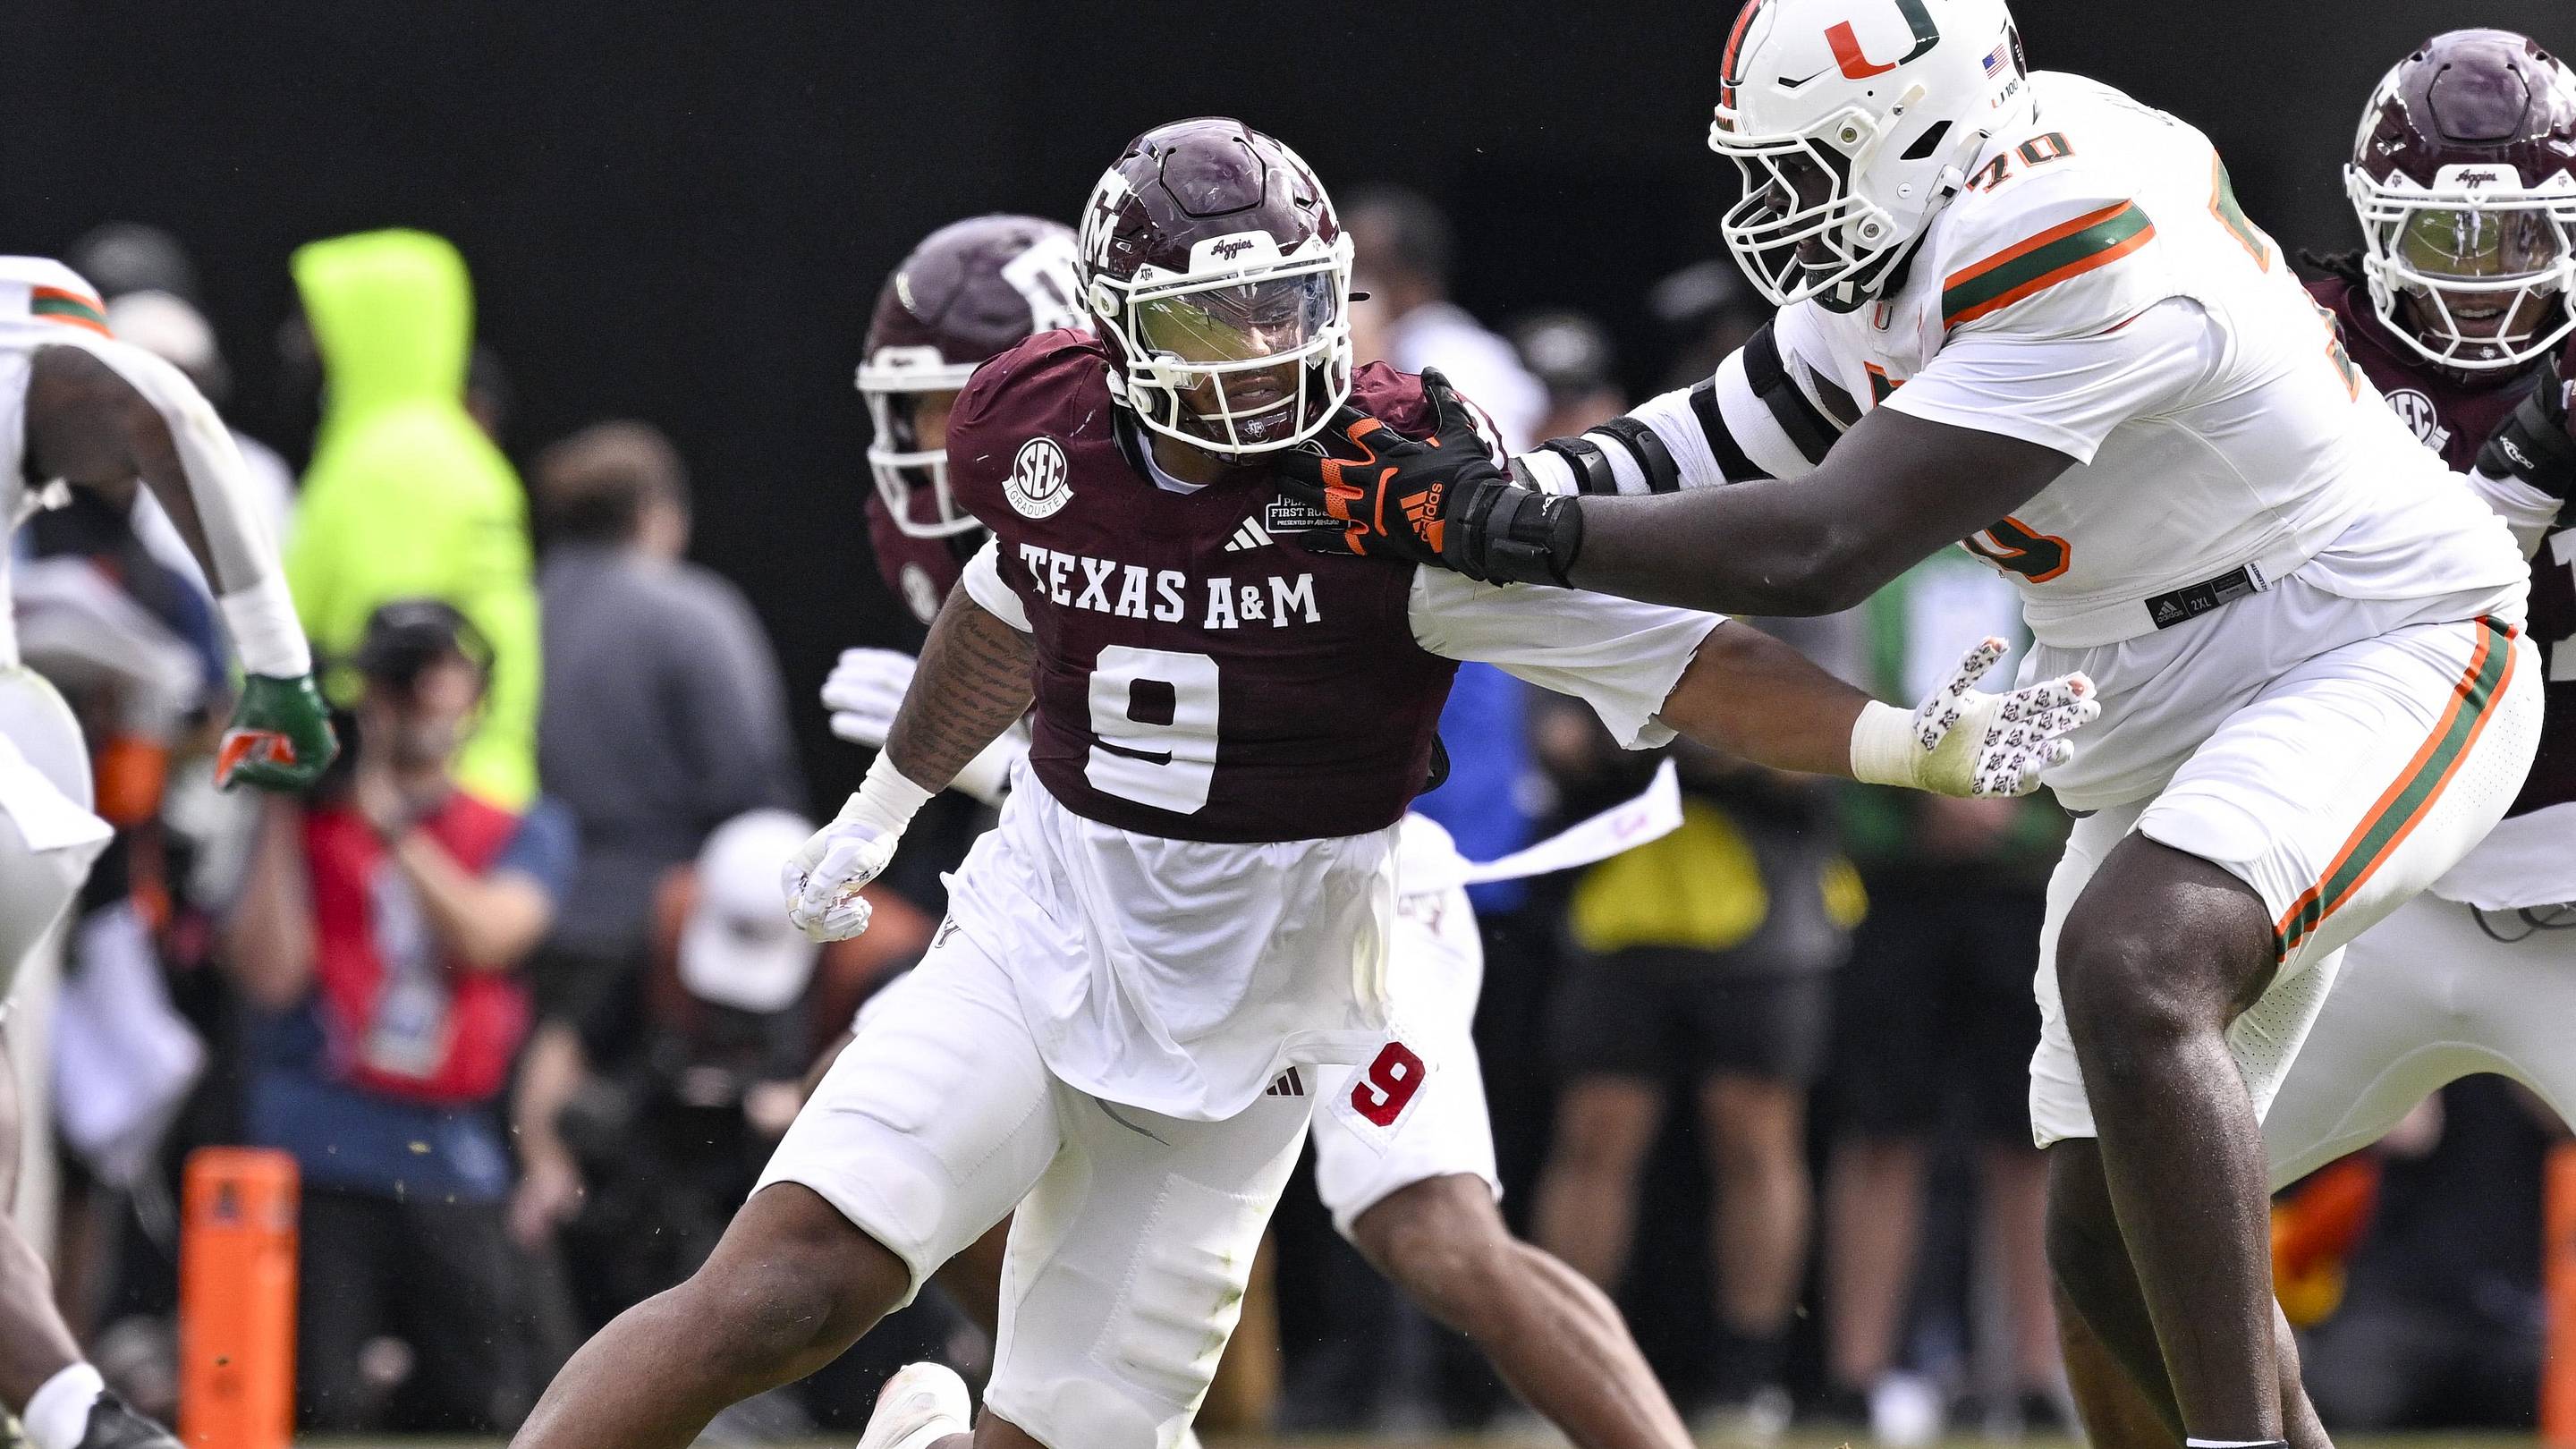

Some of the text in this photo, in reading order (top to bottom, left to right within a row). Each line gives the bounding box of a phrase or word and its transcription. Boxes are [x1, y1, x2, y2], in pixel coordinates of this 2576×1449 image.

[2005, 79, 2019, 97] 100
[1965, 131, 2074, 193] 70
[2455, 168, 2497, 189] Aggies
[1211, 239, 1254, 260] Aggies
[2386, 394, 2431, 441] EC
[1019, 442, 1063, 498] SEC
[1010, 490, 1061, 516] GRADUATE
[1271, 507, 1305, 518] FIRST
[1020, 542, 1321, 629] TEXAS A&M
[2157, 609, 2185, 623] adidas
[2190, 596, 2212, 611] 2XL
[1083, 644, 1220, 815] 9
[1351, 1041, 1426, 1128] 9
